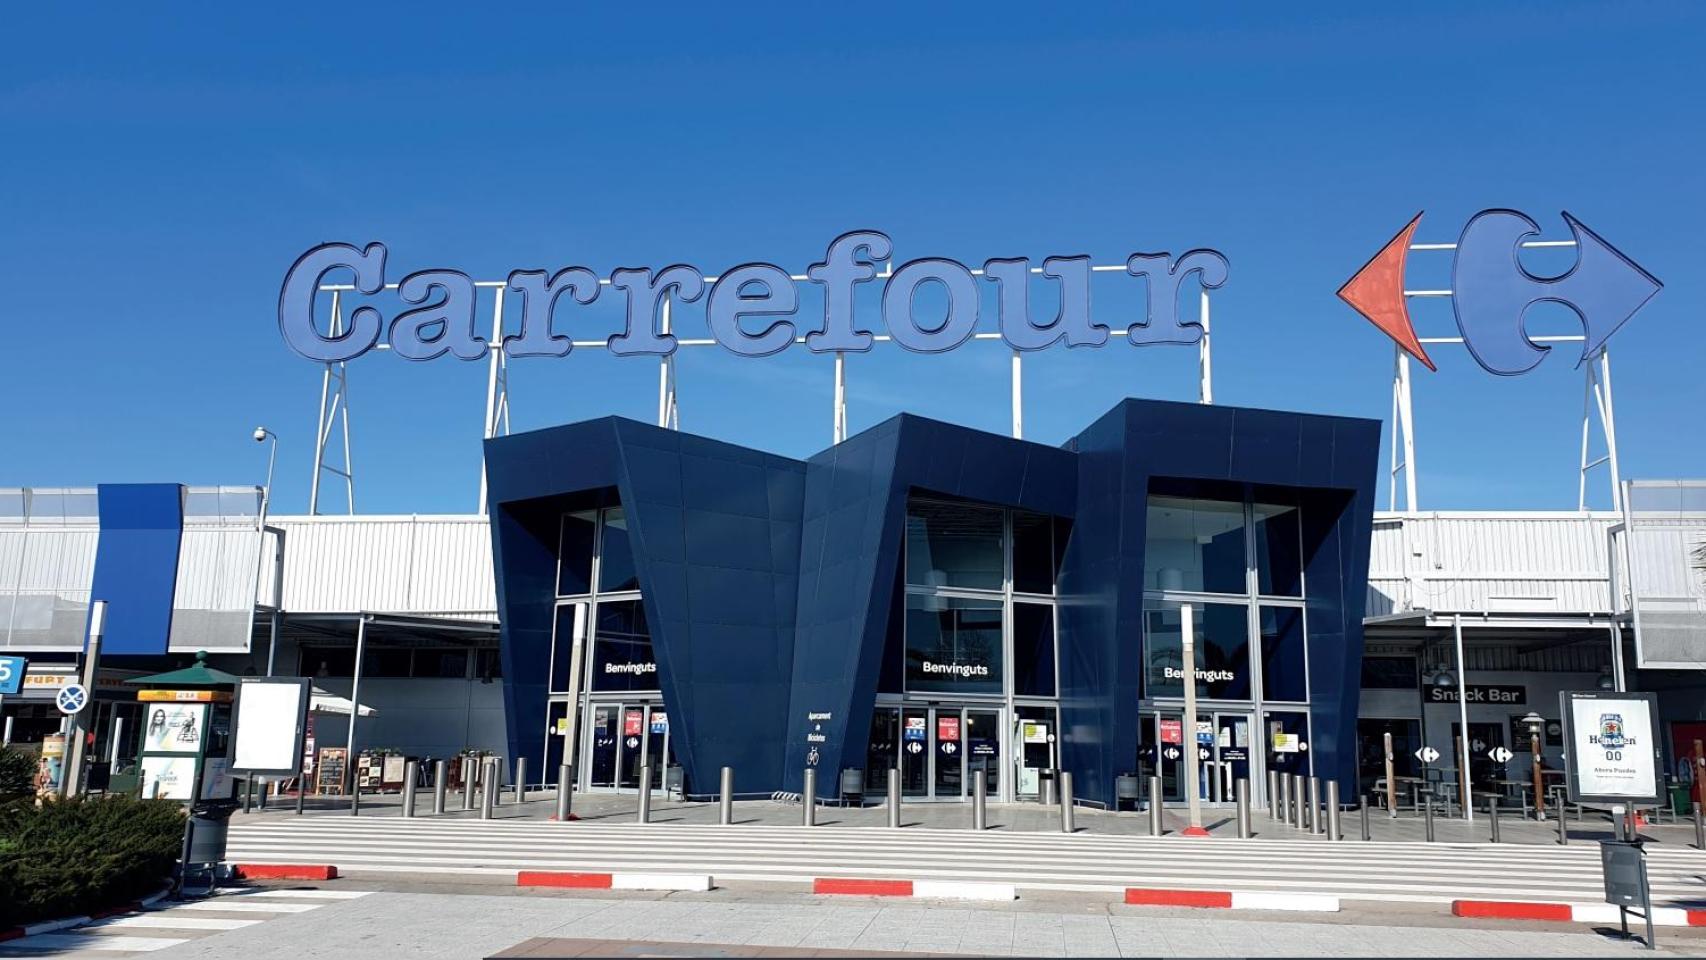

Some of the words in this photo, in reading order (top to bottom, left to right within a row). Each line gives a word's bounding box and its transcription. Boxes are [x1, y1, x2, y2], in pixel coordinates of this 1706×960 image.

[278, 229, 1230, 363] Carrefour
[605, 662, 657, 675] Benvinguts
[923, 661, 988, 676] Benvinguts
[1164, 667, 1234, 683] Beinguts
[1432, 688, 1485, 701] Snack
[1488, 688, 1520, 702] Bar
